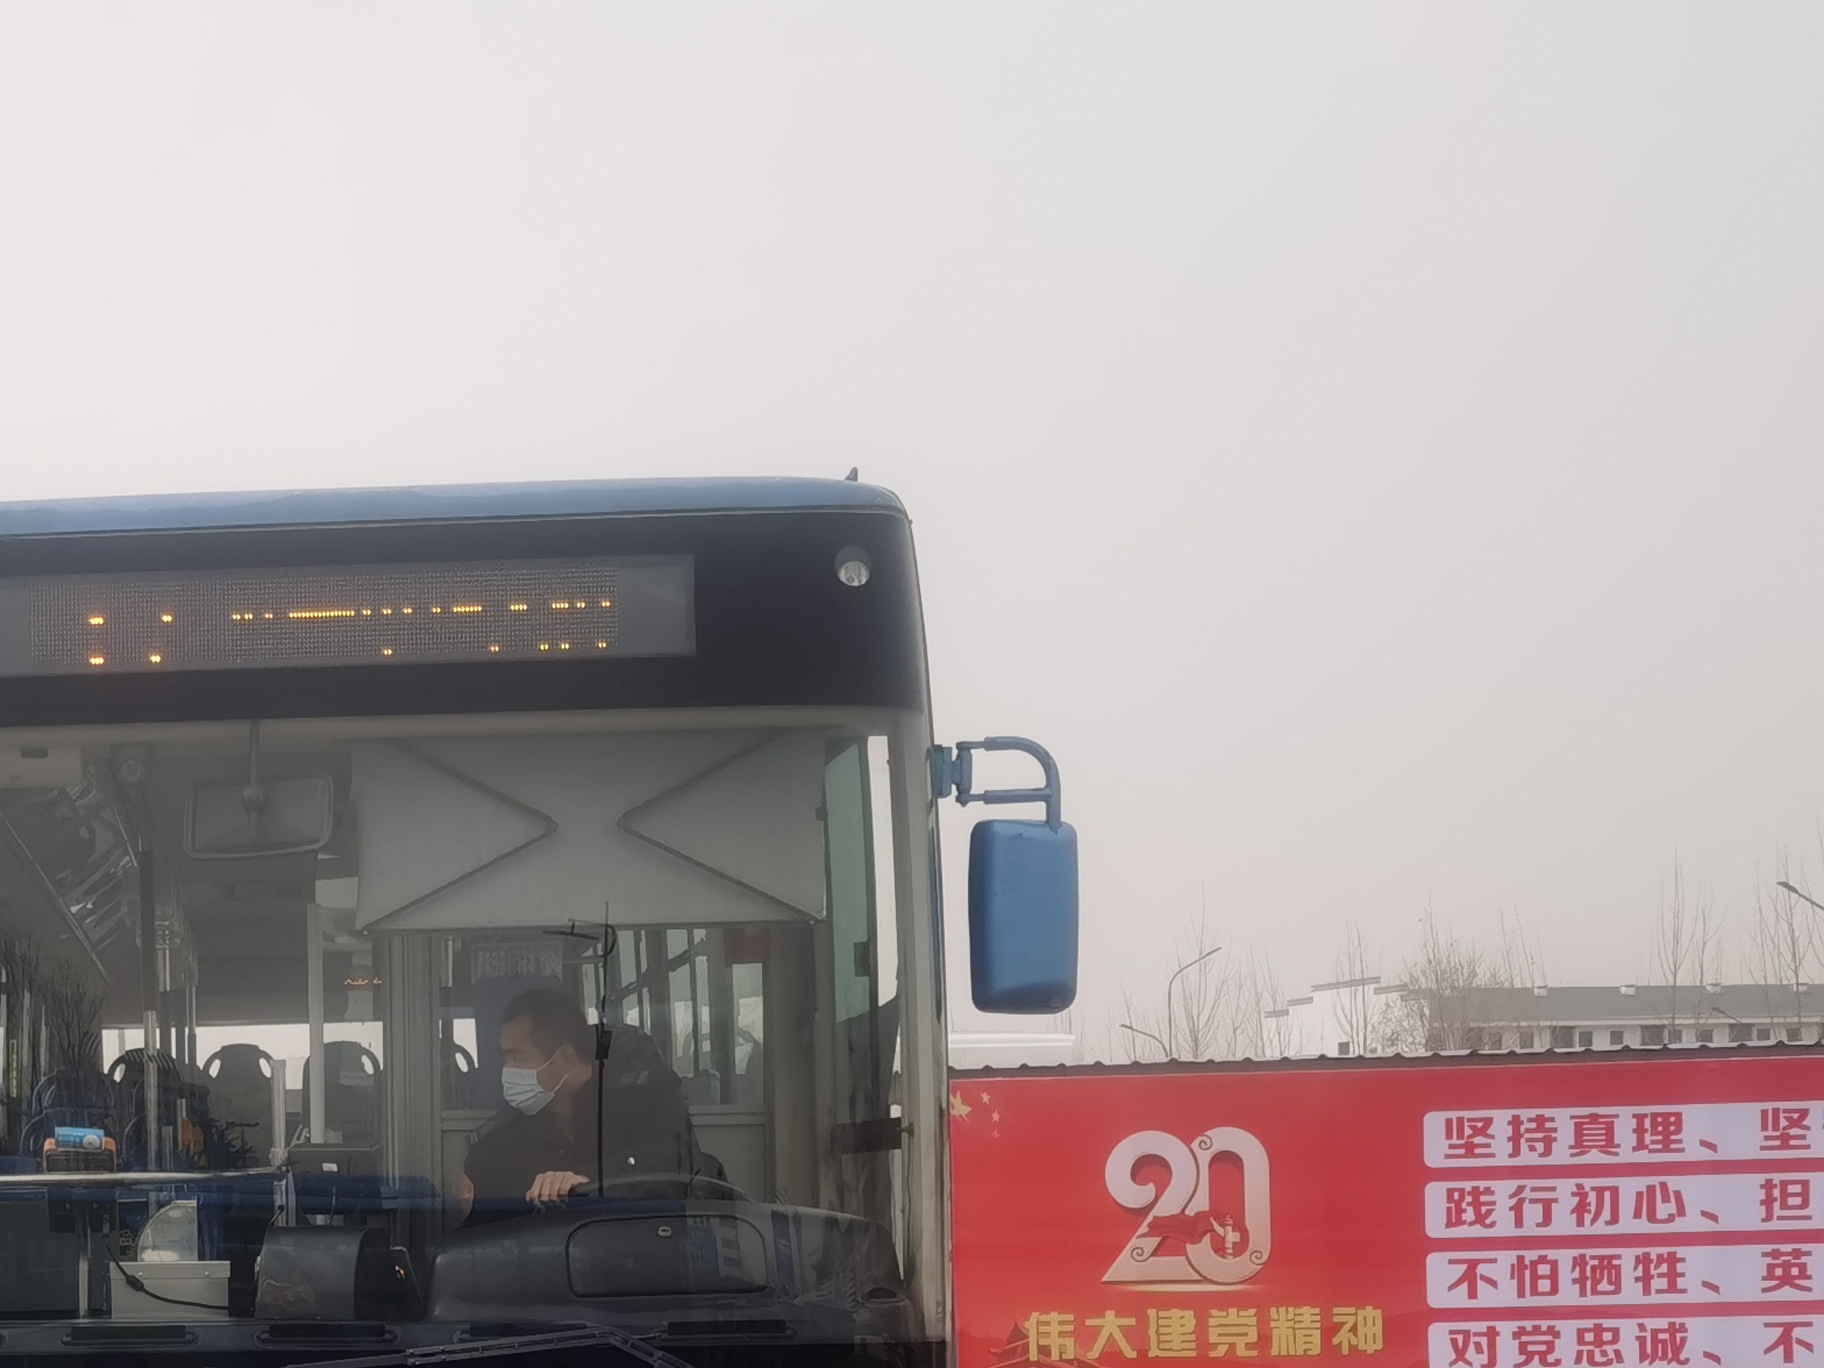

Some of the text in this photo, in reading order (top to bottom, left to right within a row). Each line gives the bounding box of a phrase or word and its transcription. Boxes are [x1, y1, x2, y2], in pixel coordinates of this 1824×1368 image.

[1101, 1126, 1272, 1285] 20
[1024, 1305, 1384, 1362] 伟大建党精神
